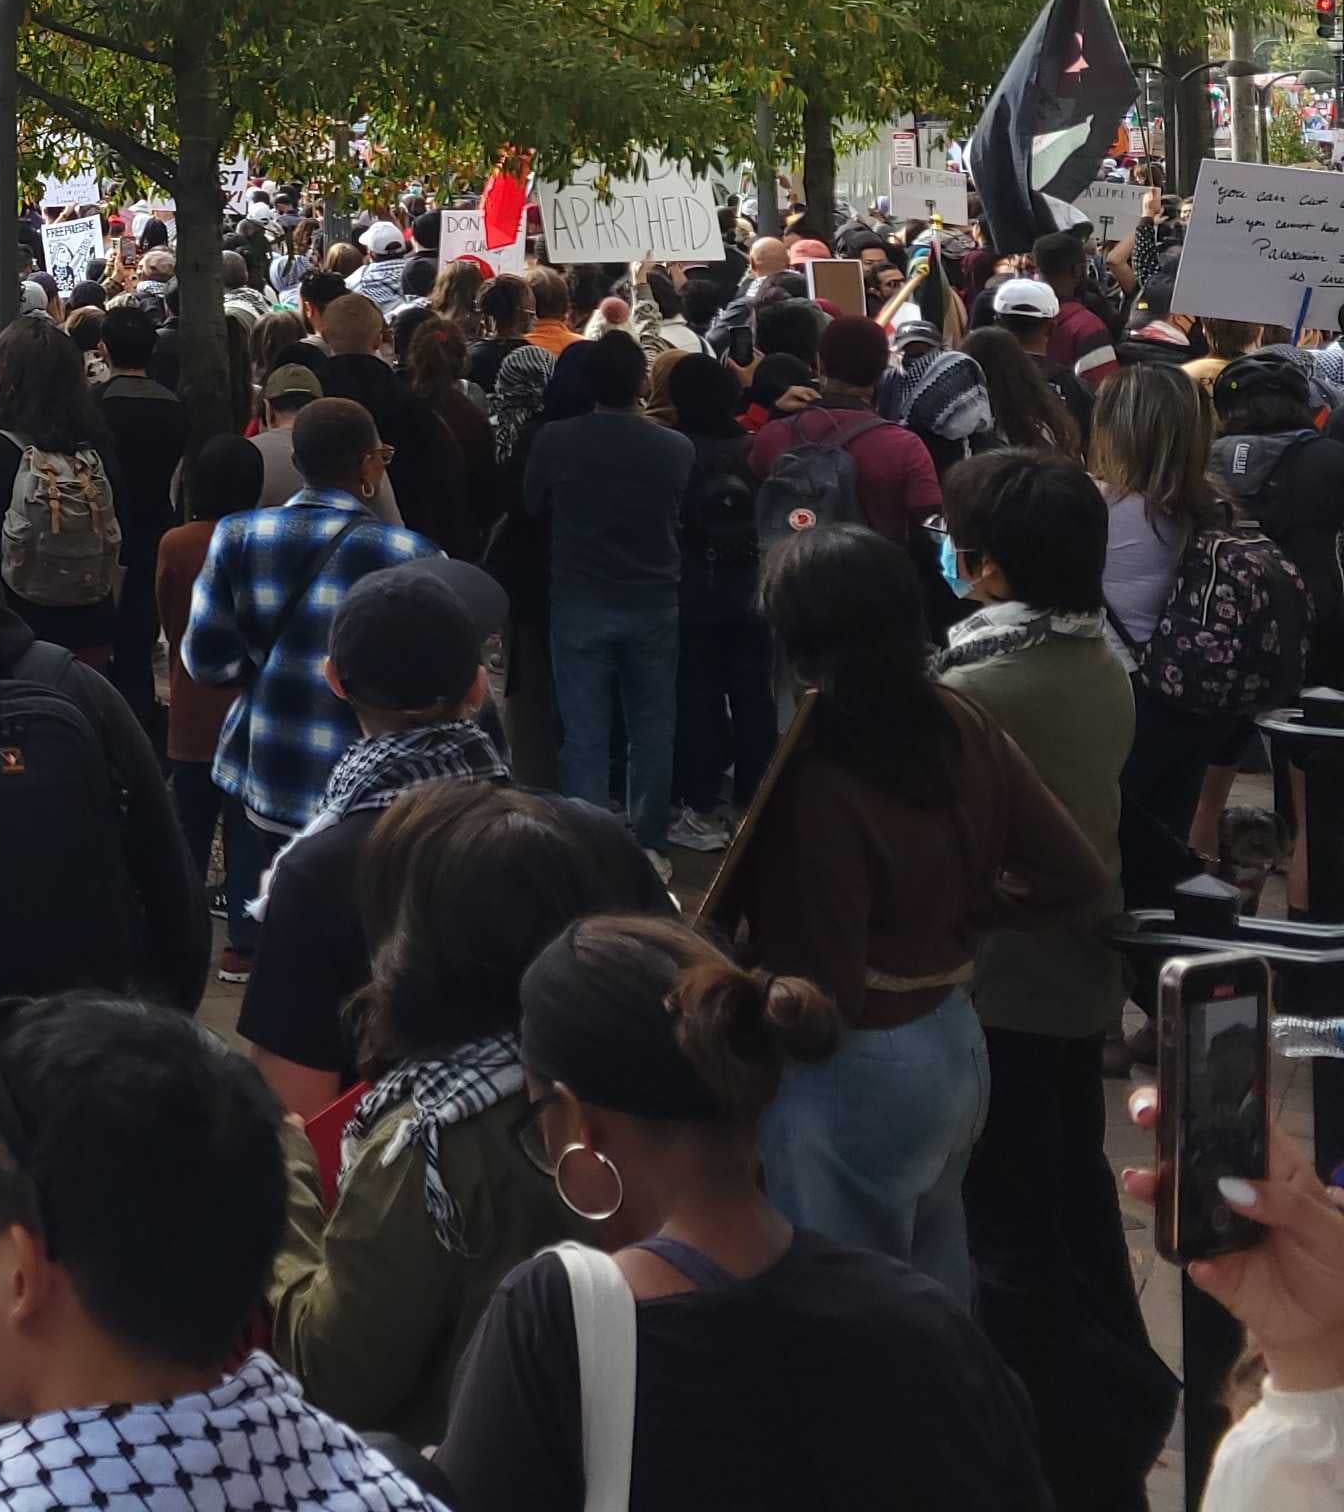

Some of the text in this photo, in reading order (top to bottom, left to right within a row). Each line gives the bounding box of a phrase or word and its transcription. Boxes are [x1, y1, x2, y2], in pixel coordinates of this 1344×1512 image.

[1257, 191, 1285, 203] can
[553, 195, 712, 252] APARTHEID
[1246, 220, 1266, 234] you
[1289, 271, 1305, 282] is
